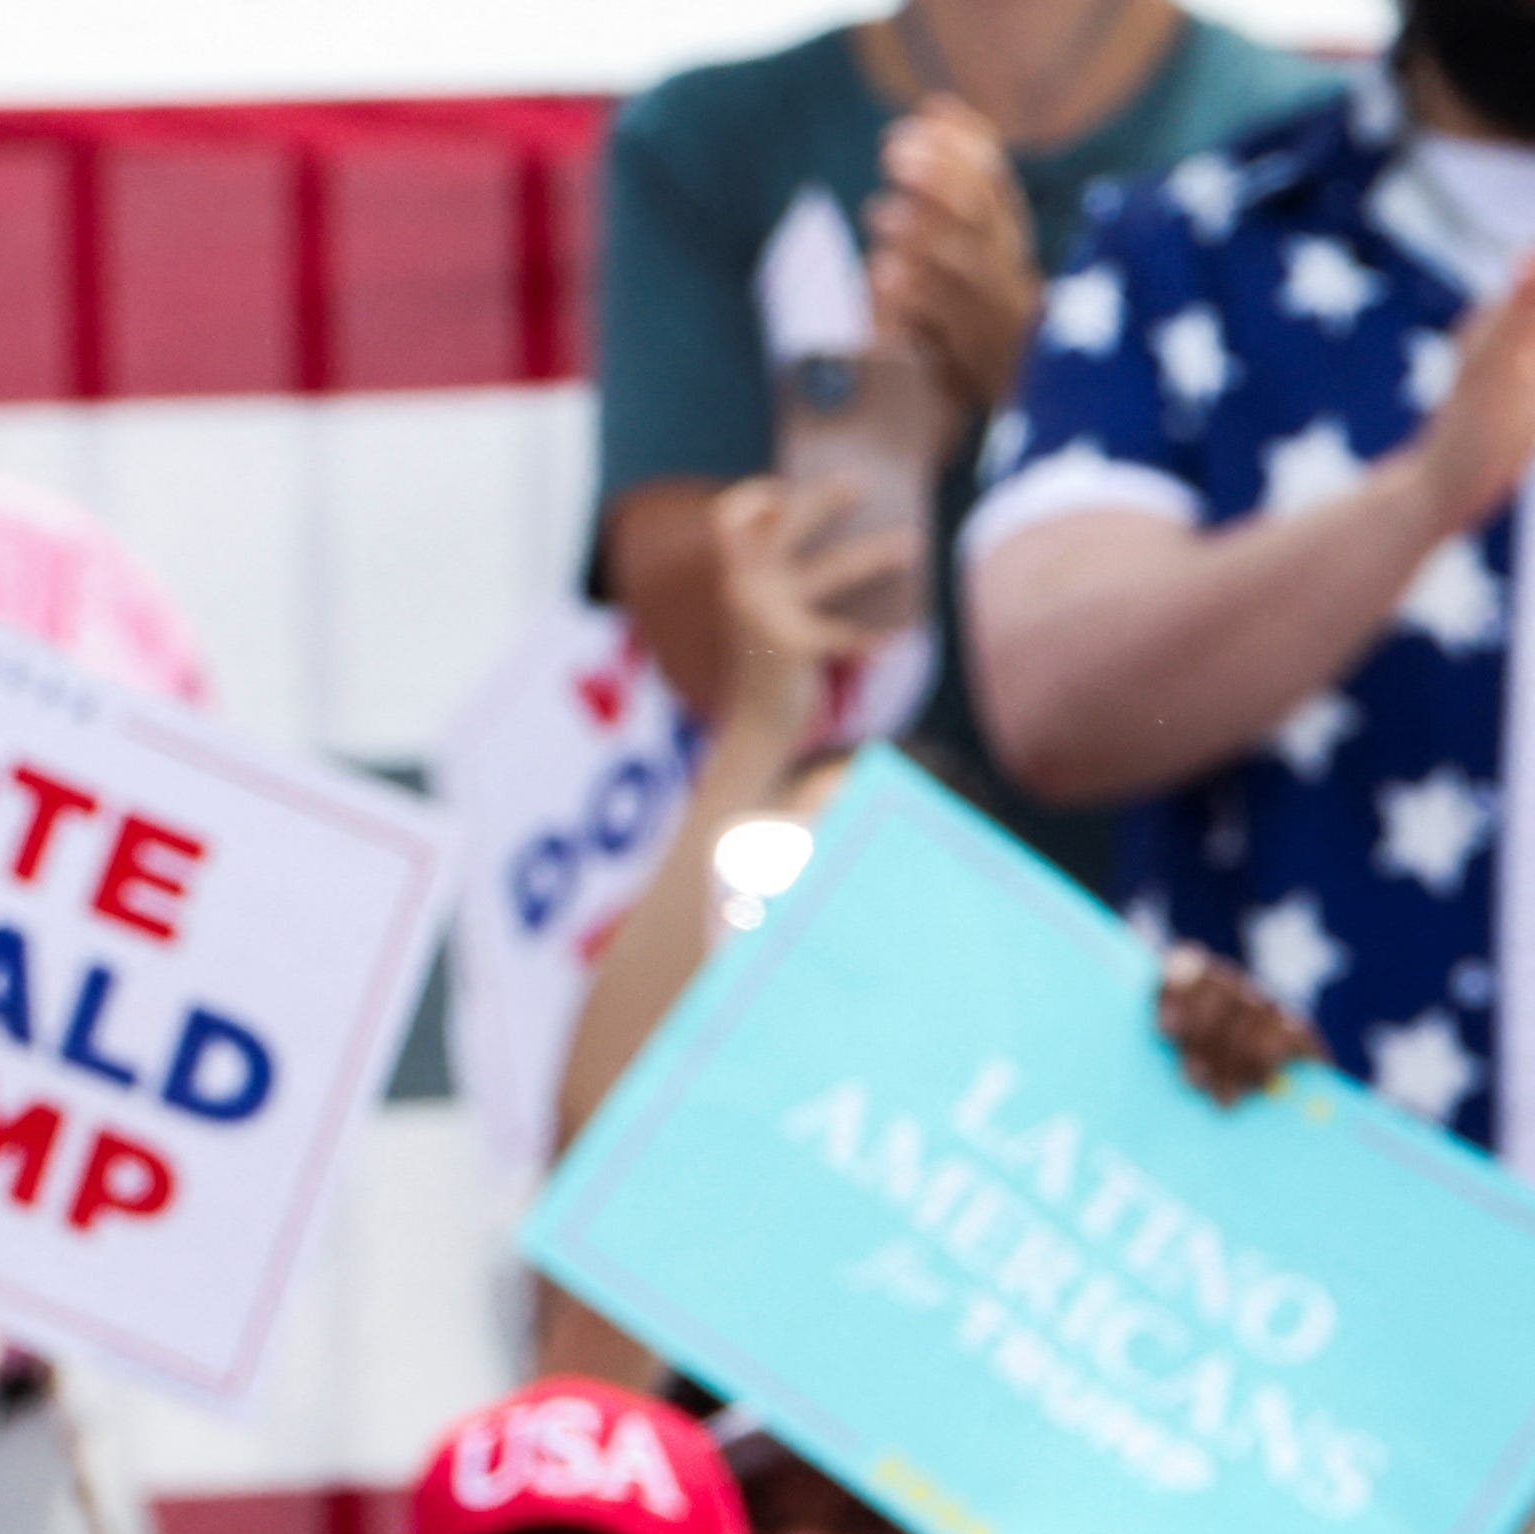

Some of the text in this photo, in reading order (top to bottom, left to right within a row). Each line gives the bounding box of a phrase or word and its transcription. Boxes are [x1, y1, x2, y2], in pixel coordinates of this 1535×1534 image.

[789, 1084, 1388, 1518] AMERICANS
[951, 1057, 1335, 1367] LATINO
[452, 1396, 691, 1521] USA
